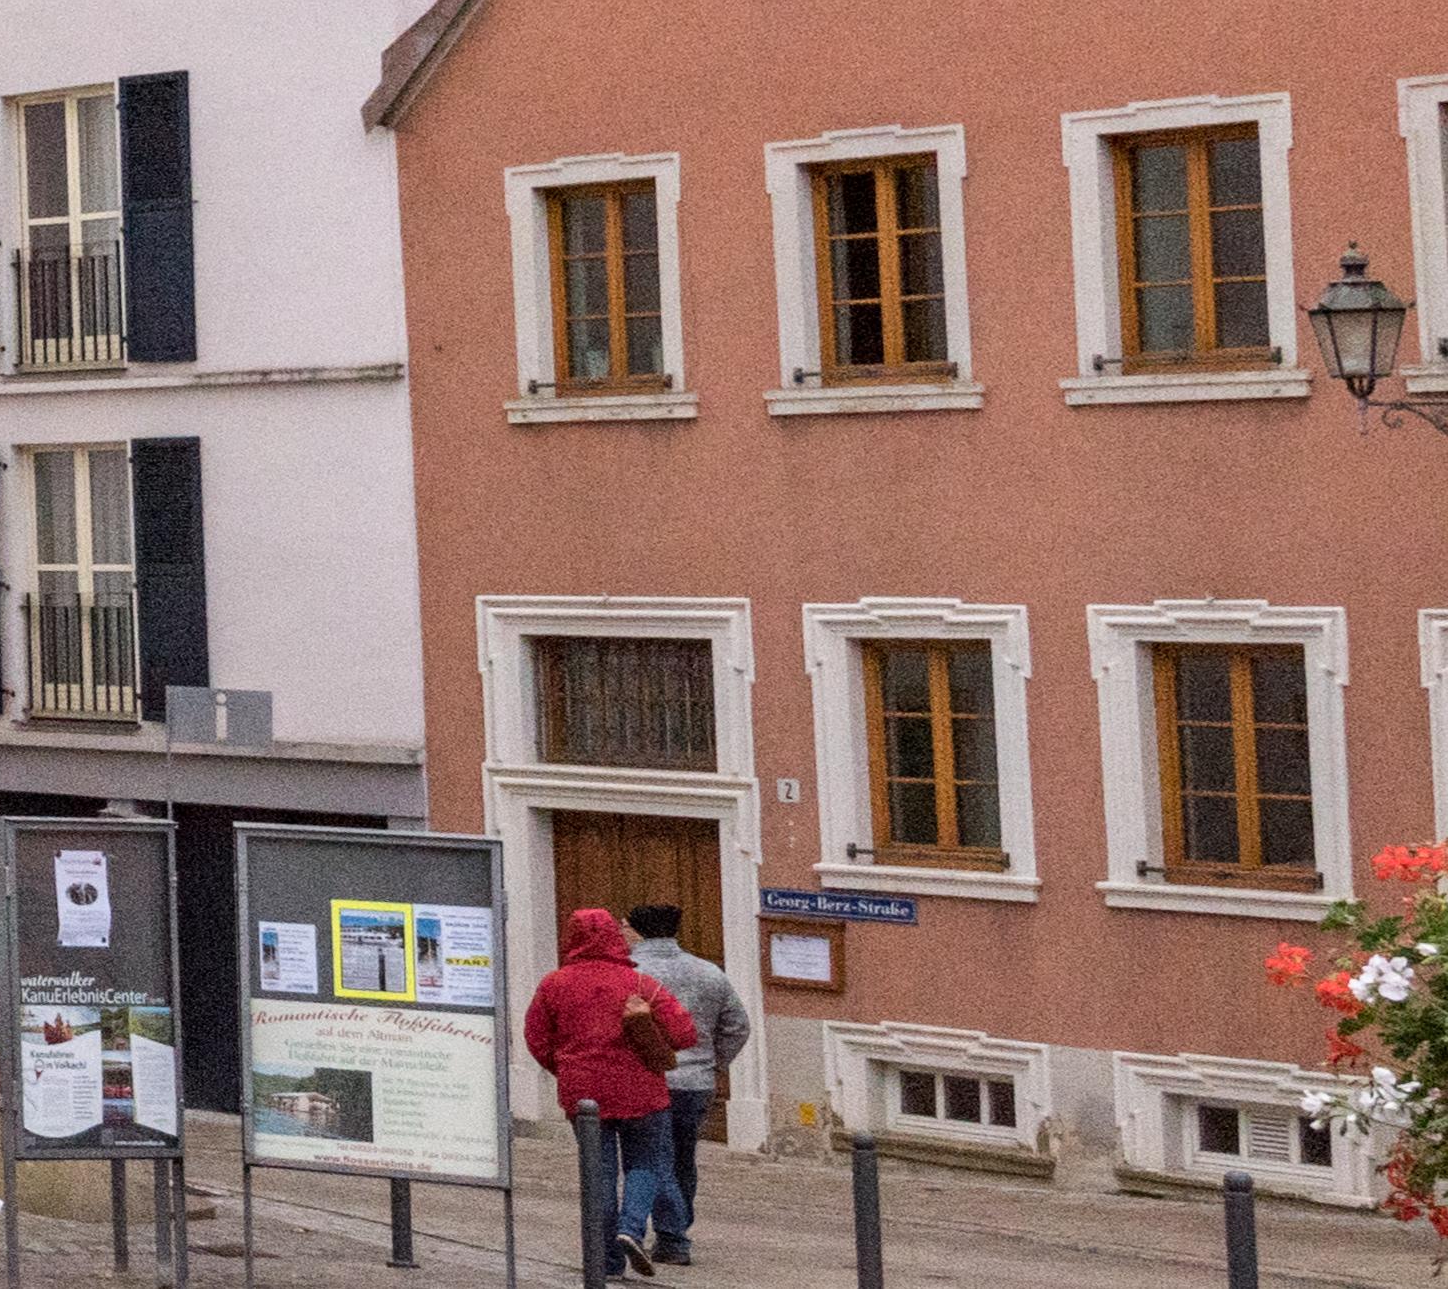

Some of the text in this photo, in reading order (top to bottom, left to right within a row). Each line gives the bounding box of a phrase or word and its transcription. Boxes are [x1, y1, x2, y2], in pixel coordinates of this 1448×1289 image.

[784, 782, 793, 800] 2
[766, 893, 910, 917] Georg-Berz-Straße
[20, 971, 96, 987] waterwalker
[21, 988, 148, 1005] KanuErlebnisCenter
[251, 1008, 369, 1025] Romantische
